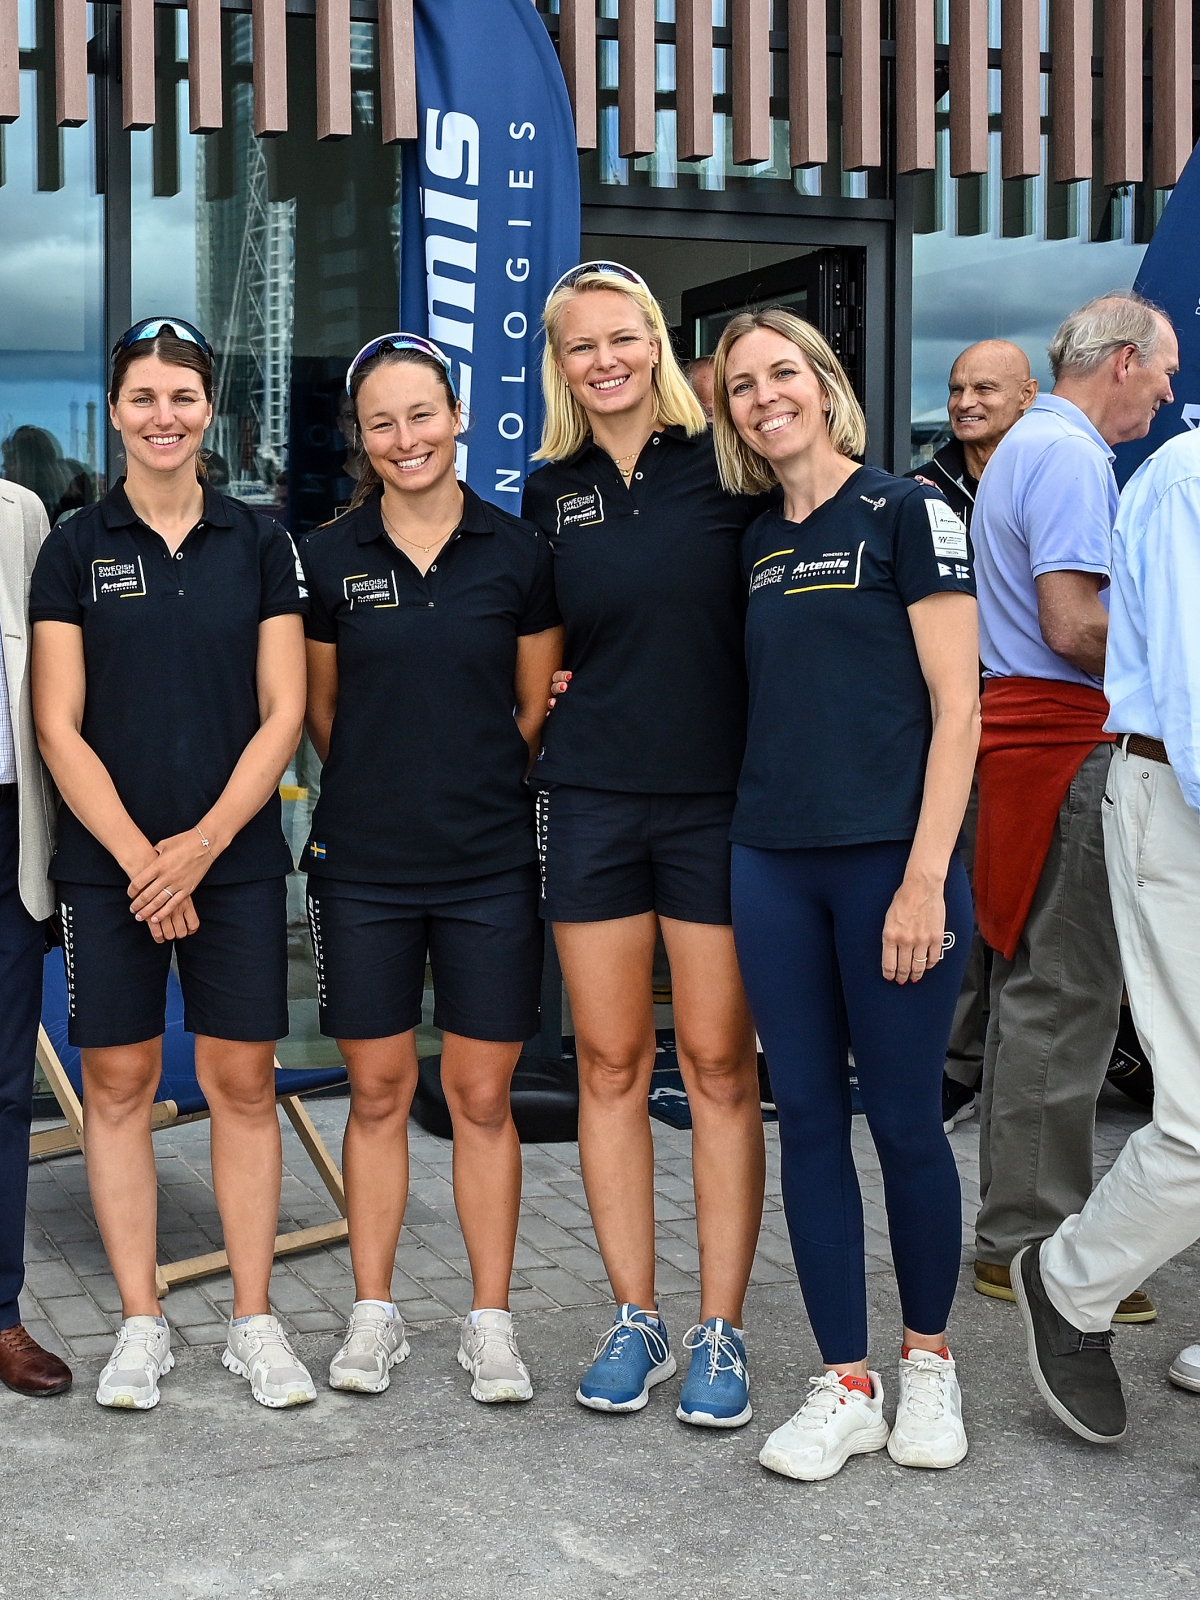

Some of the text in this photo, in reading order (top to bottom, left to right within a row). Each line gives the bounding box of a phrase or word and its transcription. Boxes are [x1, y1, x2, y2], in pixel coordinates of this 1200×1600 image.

[495, 120, 537, 493] NOLOGIES
[563, 493, 595, 508] SWEDISH
[98, 563, 135, 574] SWEDISH
[792, 558, 850, 575] Artemis
[98, 569, 136, 578] CHALLENGE
[351, 578, 388, 589] SWEDISH
[351, 583, 389, 593] CHALLENGE
